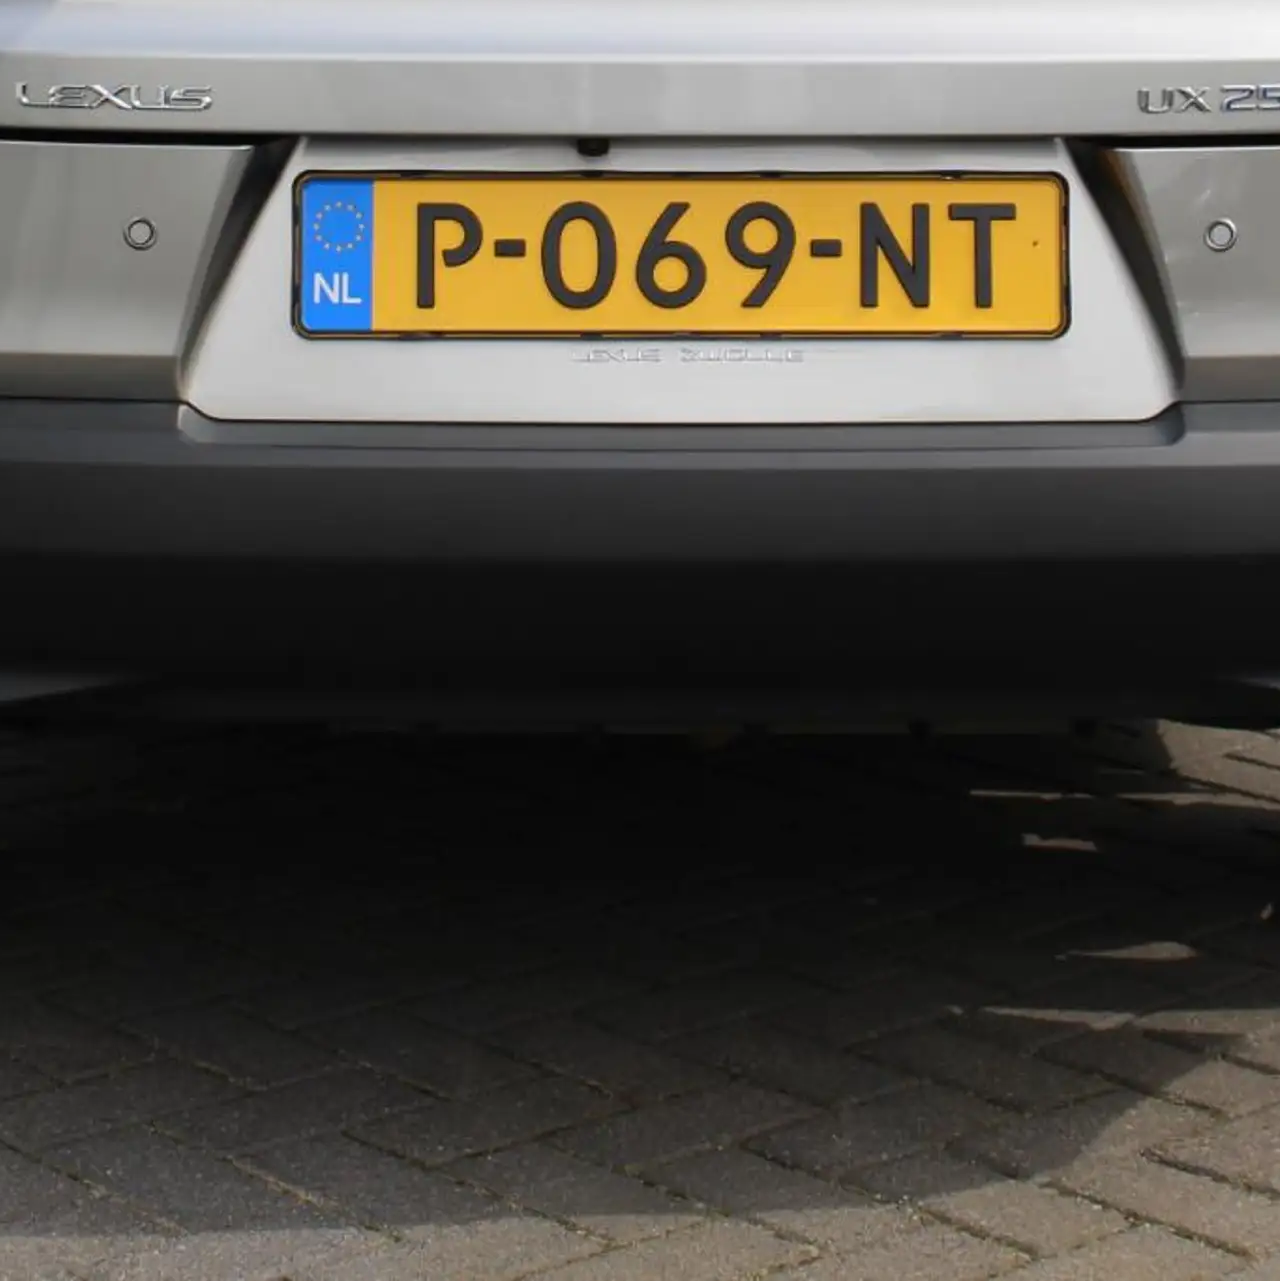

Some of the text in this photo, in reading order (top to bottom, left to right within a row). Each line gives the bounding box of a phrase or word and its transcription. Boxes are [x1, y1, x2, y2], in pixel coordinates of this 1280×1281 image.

[16, 81, 213, 111] LEXUS
[1136, 86, 1212, 114] UX
[416, 201, 1016, 308] P-069-NT
[313, 272, 362, 304] NL
